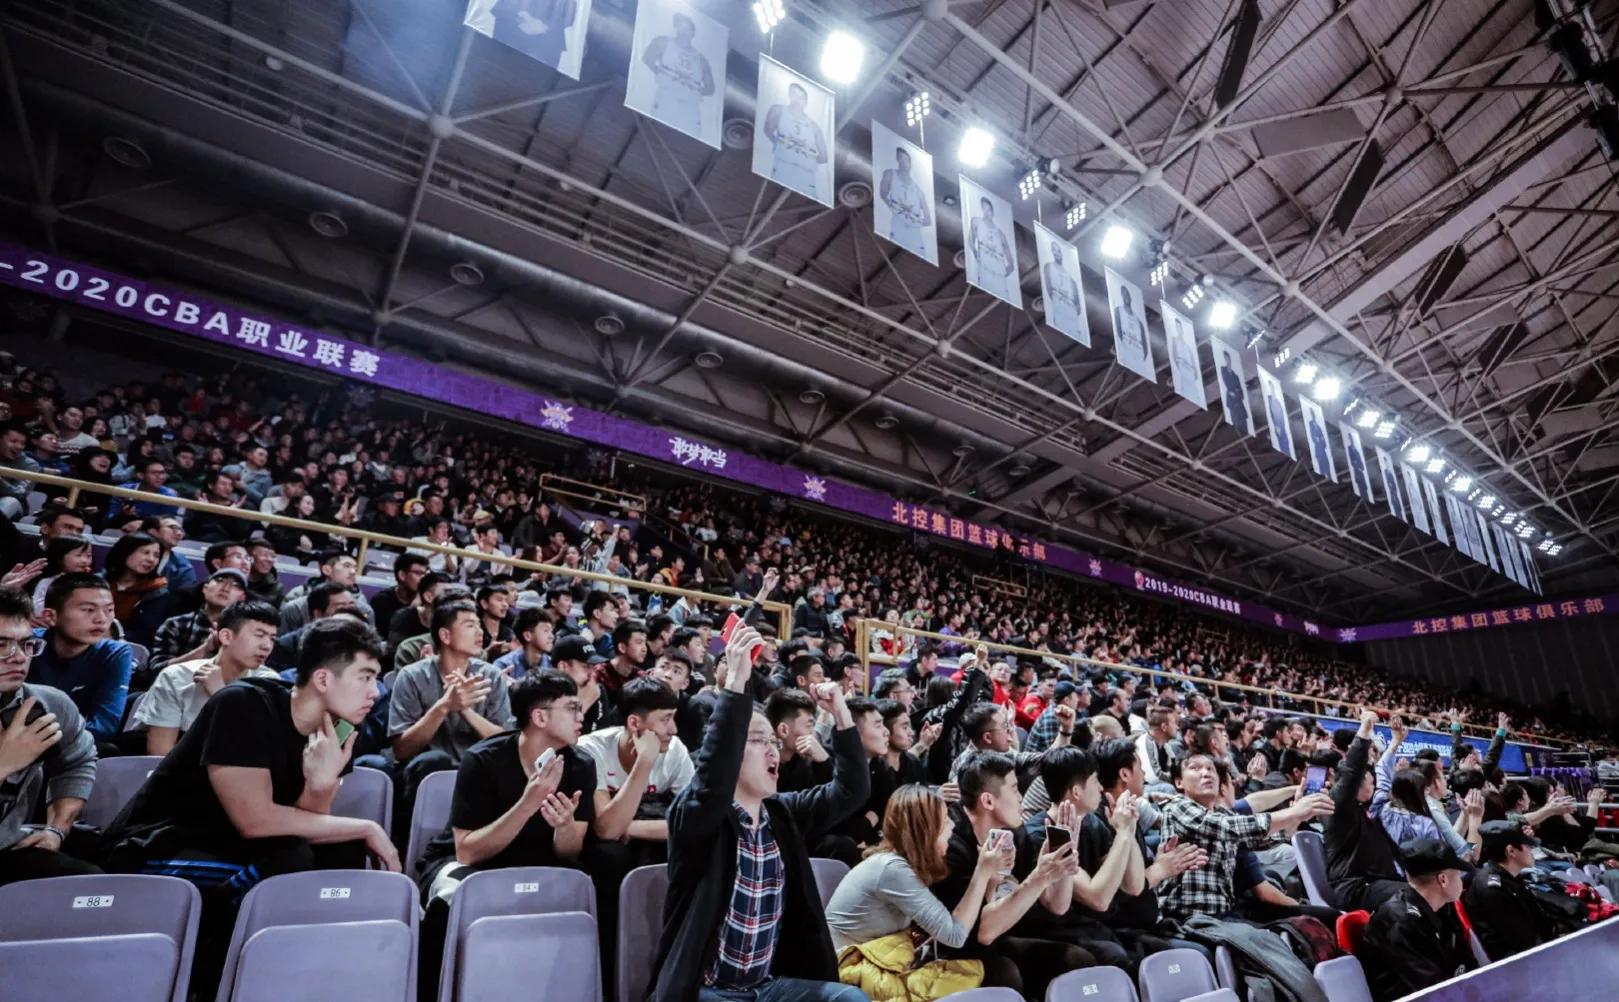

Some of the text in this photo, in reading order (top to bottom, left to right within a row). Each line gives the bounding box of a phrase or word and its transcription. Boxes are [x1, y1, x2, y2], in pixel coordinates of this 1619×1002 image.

[1412, 598, 1605, 635] 北控集团篮球俱乐部
[331, 889, 341, 897] 86
[86, 896, 101, 907] 88
